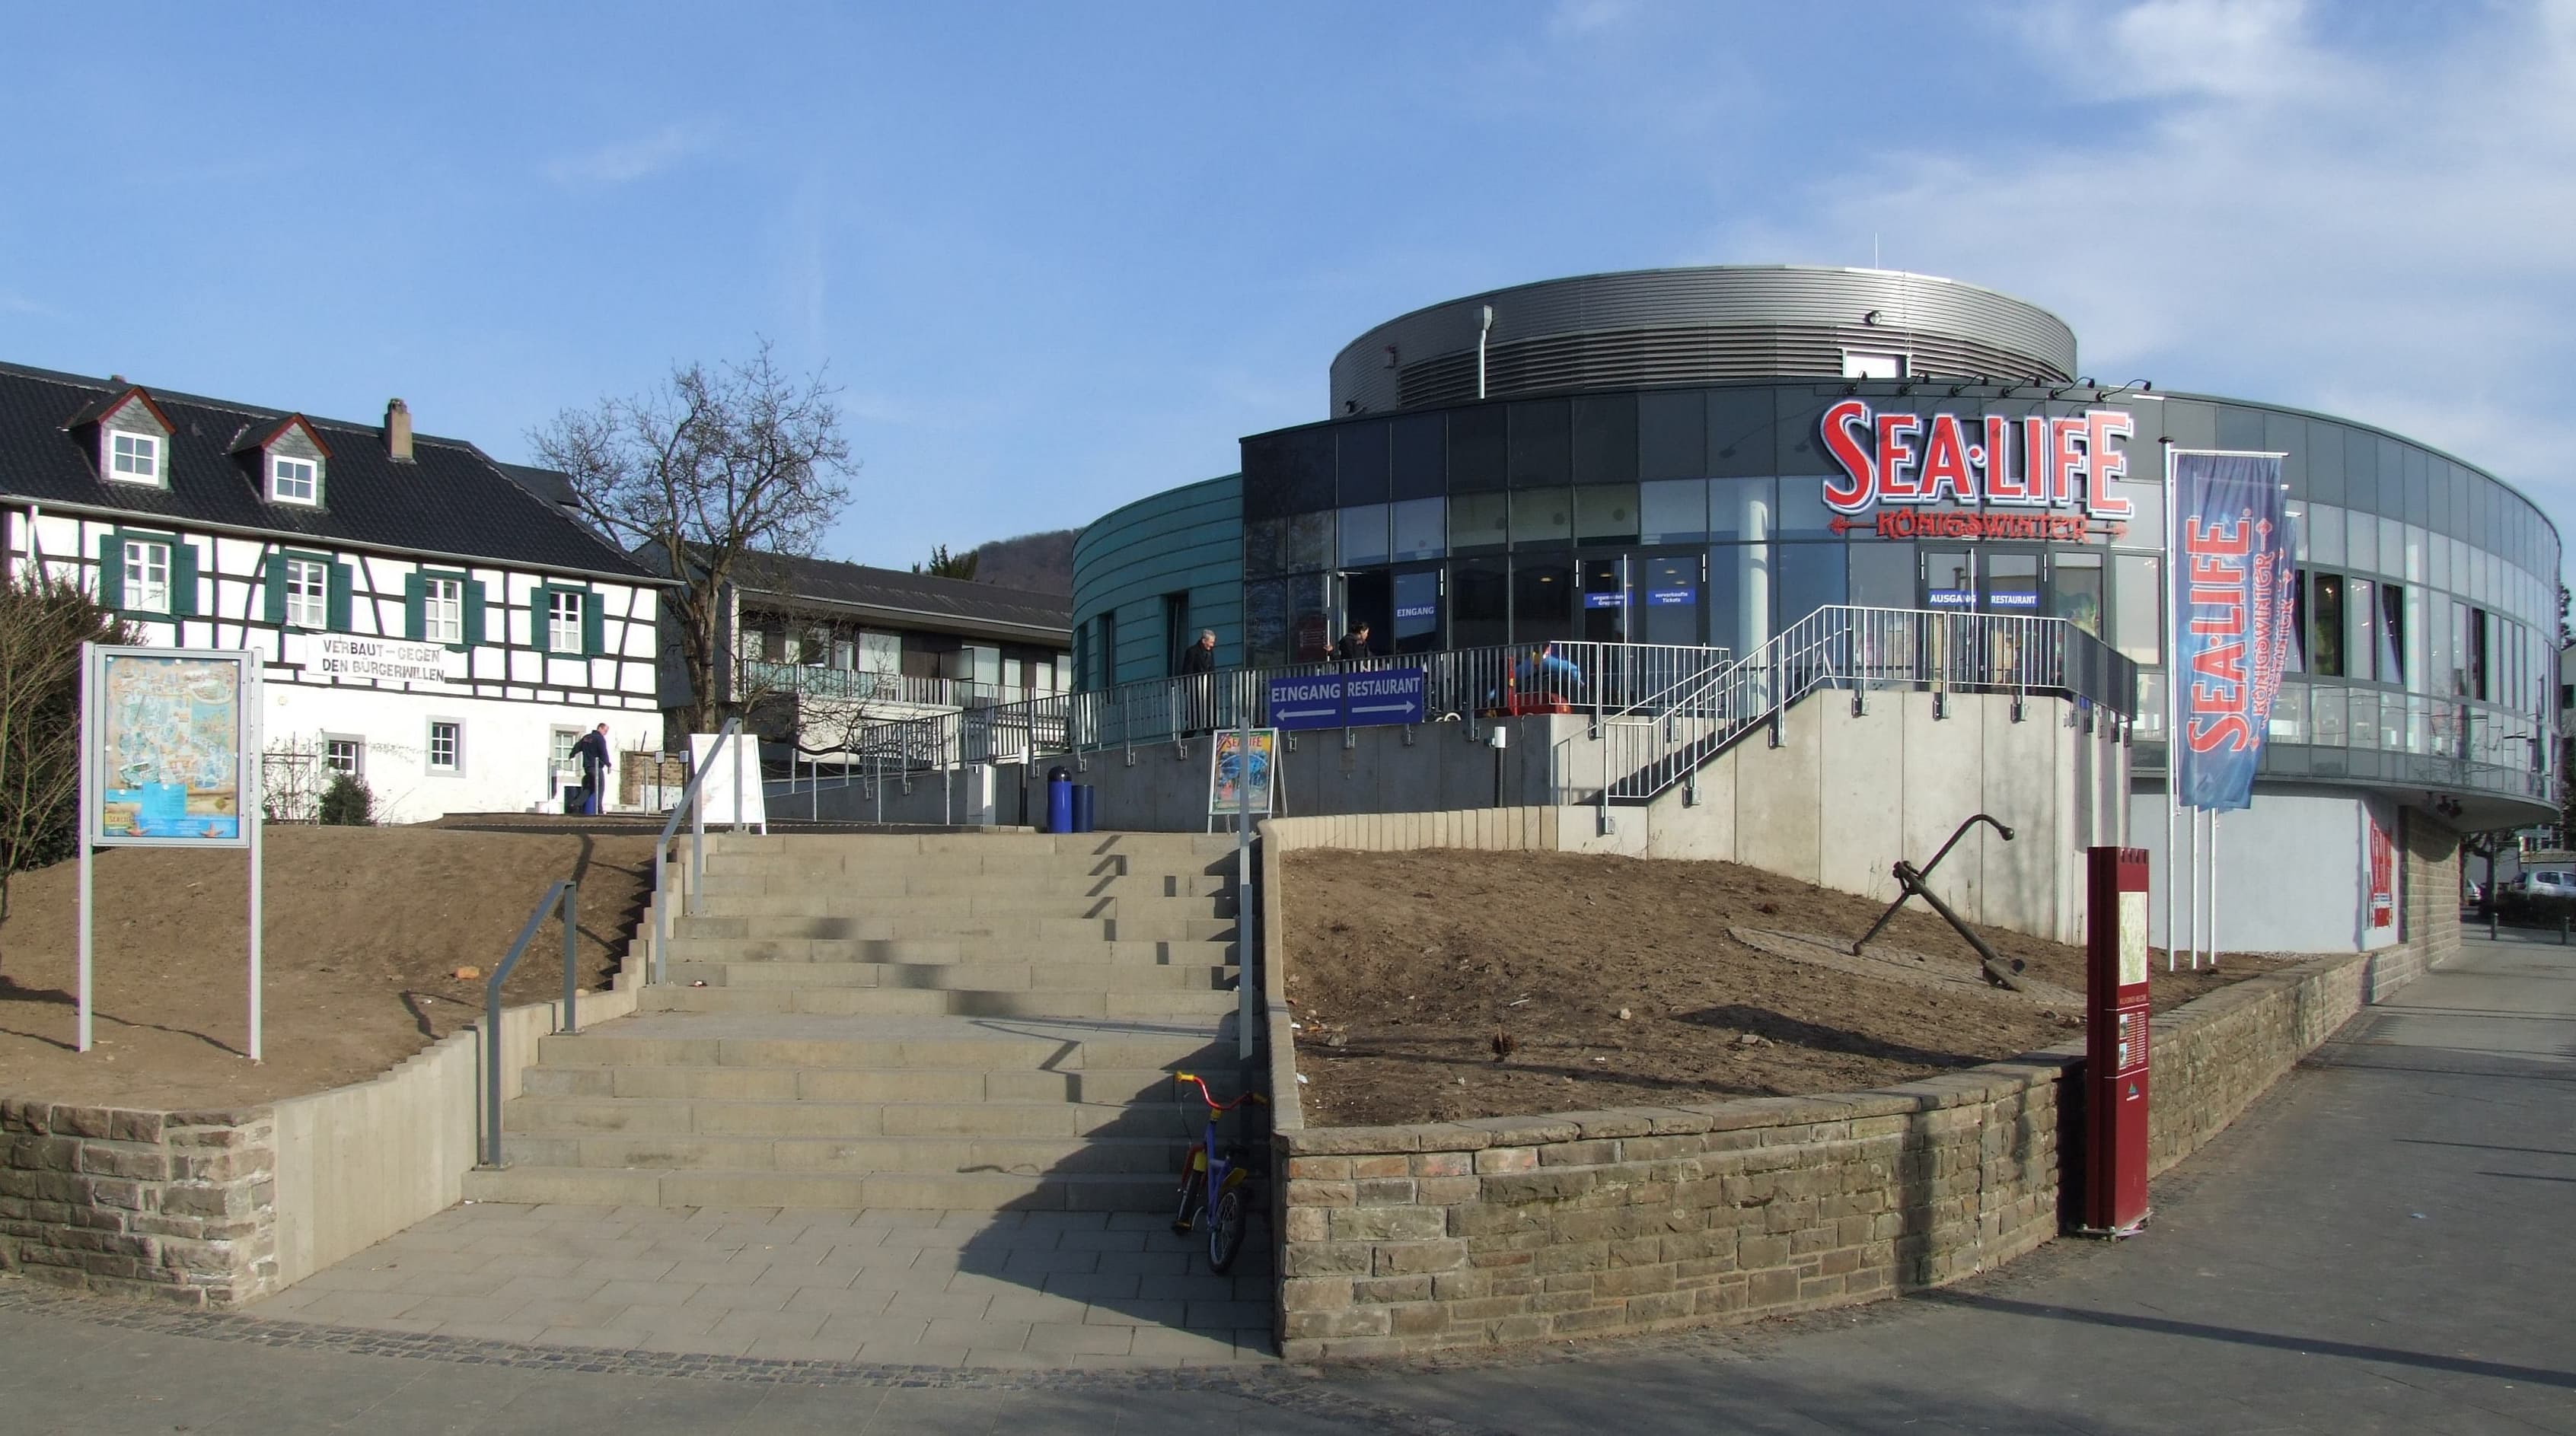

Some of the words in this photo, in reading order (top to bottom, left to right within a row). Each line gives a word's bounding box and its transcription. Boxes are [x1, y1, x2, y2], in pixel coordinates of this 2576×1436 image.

[1991, 595, 2037, 604] RESTAURANT
[1397, 607, 1434, 617] EINGANG
[323, 639, 384, 658] VERBAUT
[397, 648, 440, 663] GEGEN
[323, 658, 348, 673] DEN
[352, 657, 445, 682] BÜRGERWILLEN
[1271, 683, 1341, 702] EINGANG
[1347, 677, 1420, 697] RESTAURANT
